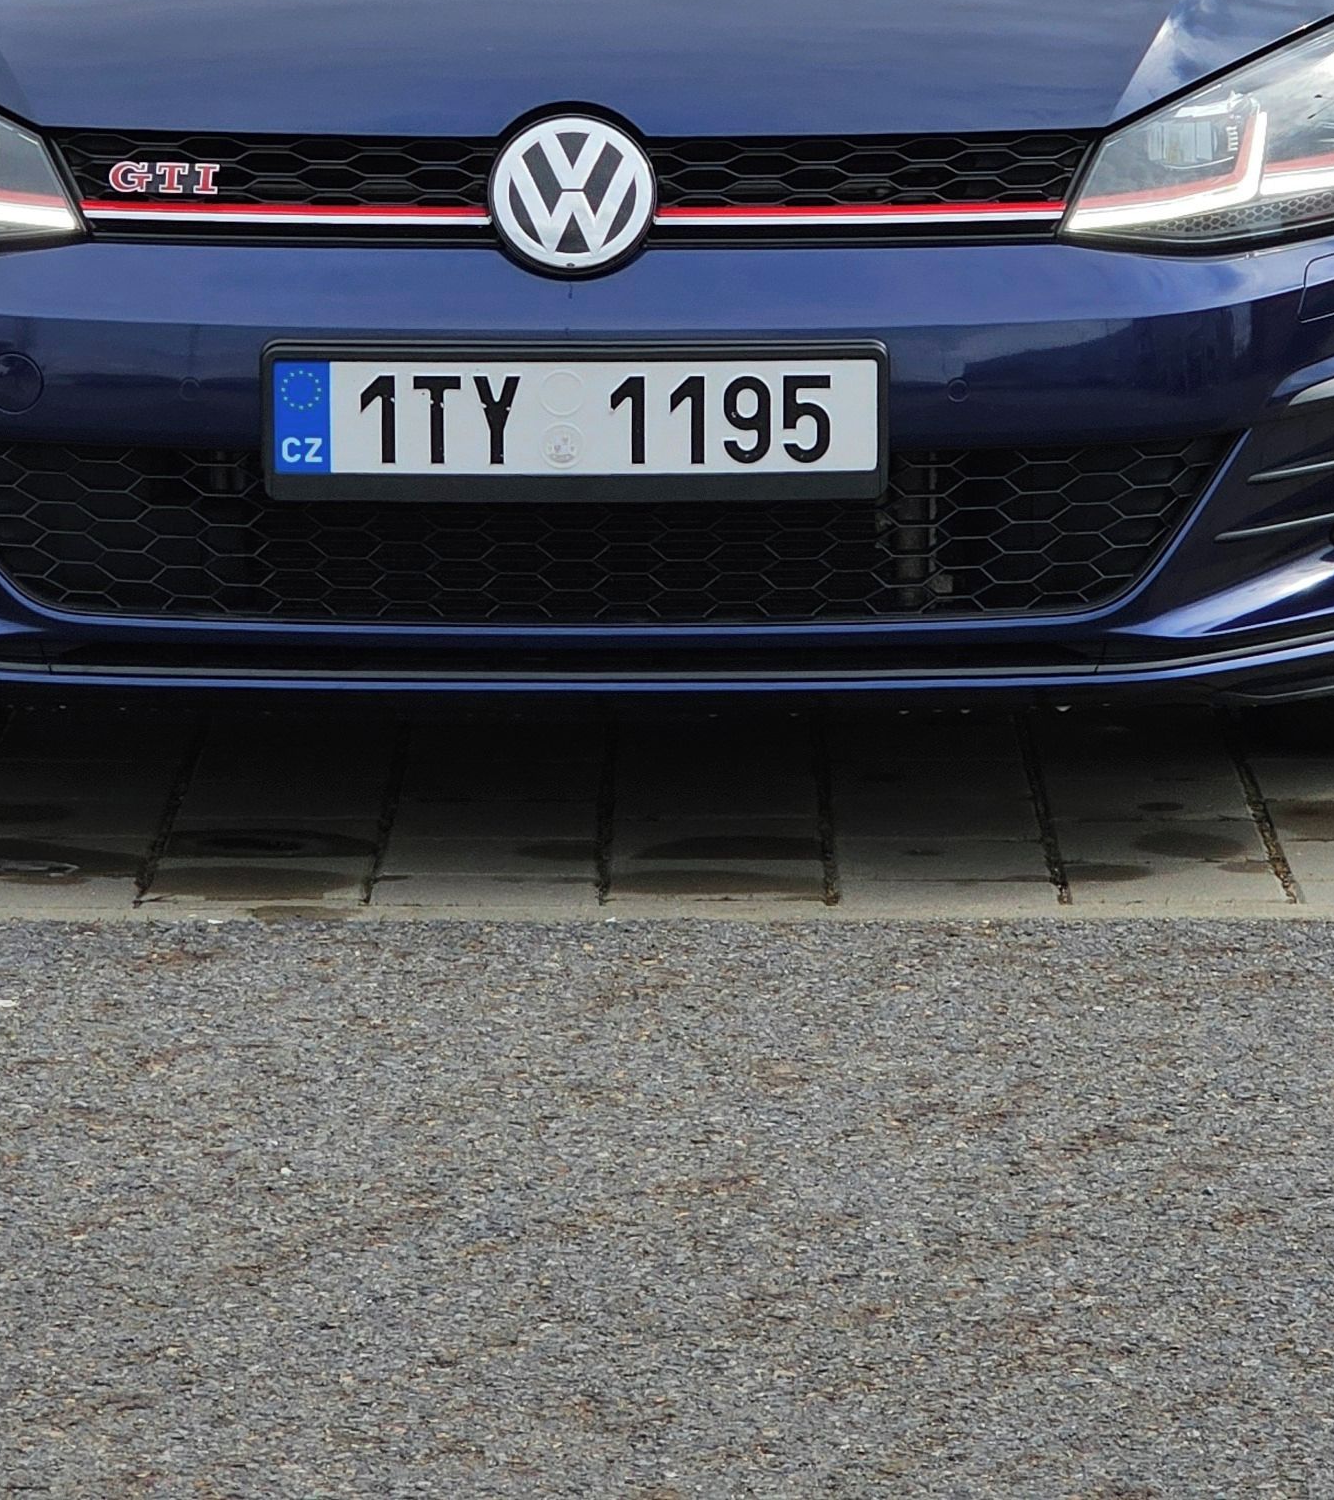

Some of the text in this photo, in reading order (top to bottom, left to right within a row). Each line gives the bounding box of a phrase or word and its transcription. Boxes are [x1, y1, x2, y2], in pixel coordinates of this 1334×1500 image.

[108, 161, 220, 195] GTI
[360, 374, 831, 465] 1TY 1195
[281, 436, 323, 463] CZ
